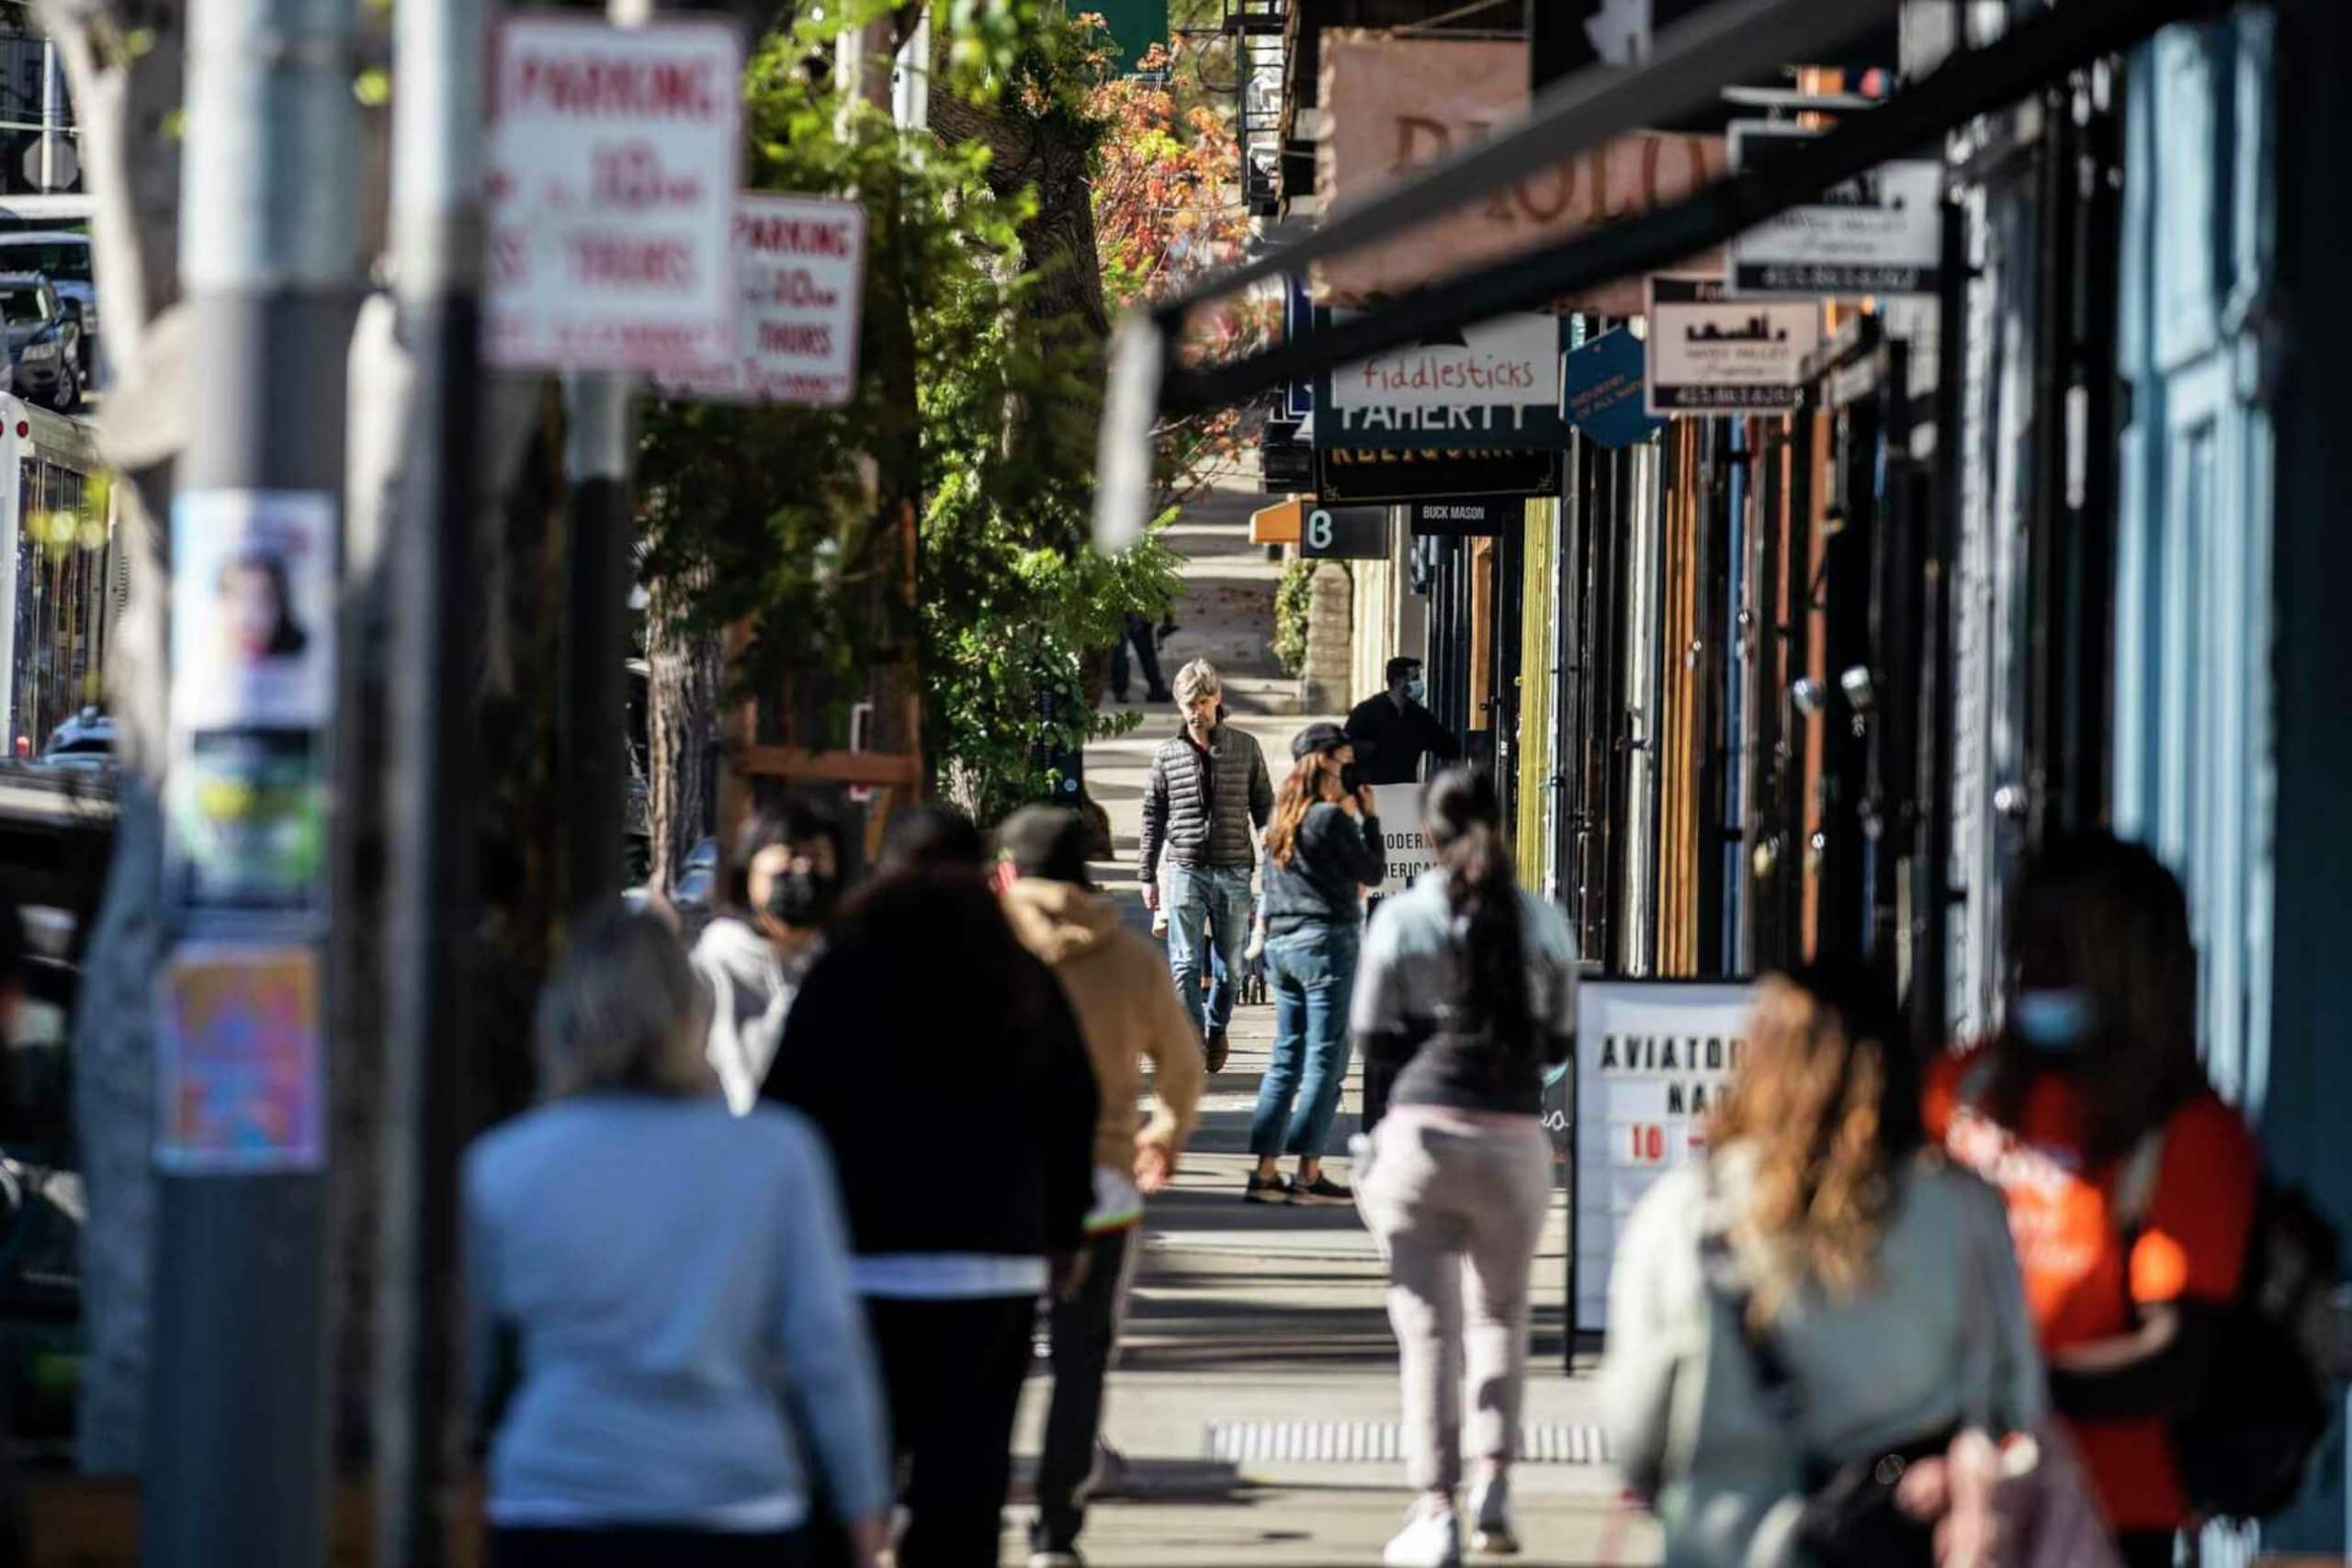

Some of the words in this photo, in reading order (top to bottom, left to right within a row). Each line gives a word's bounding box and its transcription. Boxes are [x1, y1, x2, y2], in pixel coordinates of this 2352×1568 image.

[1363, 354, 1535, 391] fiddlesticks
[1422, 505, 1448, 520] BUCK
[1450, 505, 1486, 520] MASON
[1631, 1124, 1666, 1161] 10
